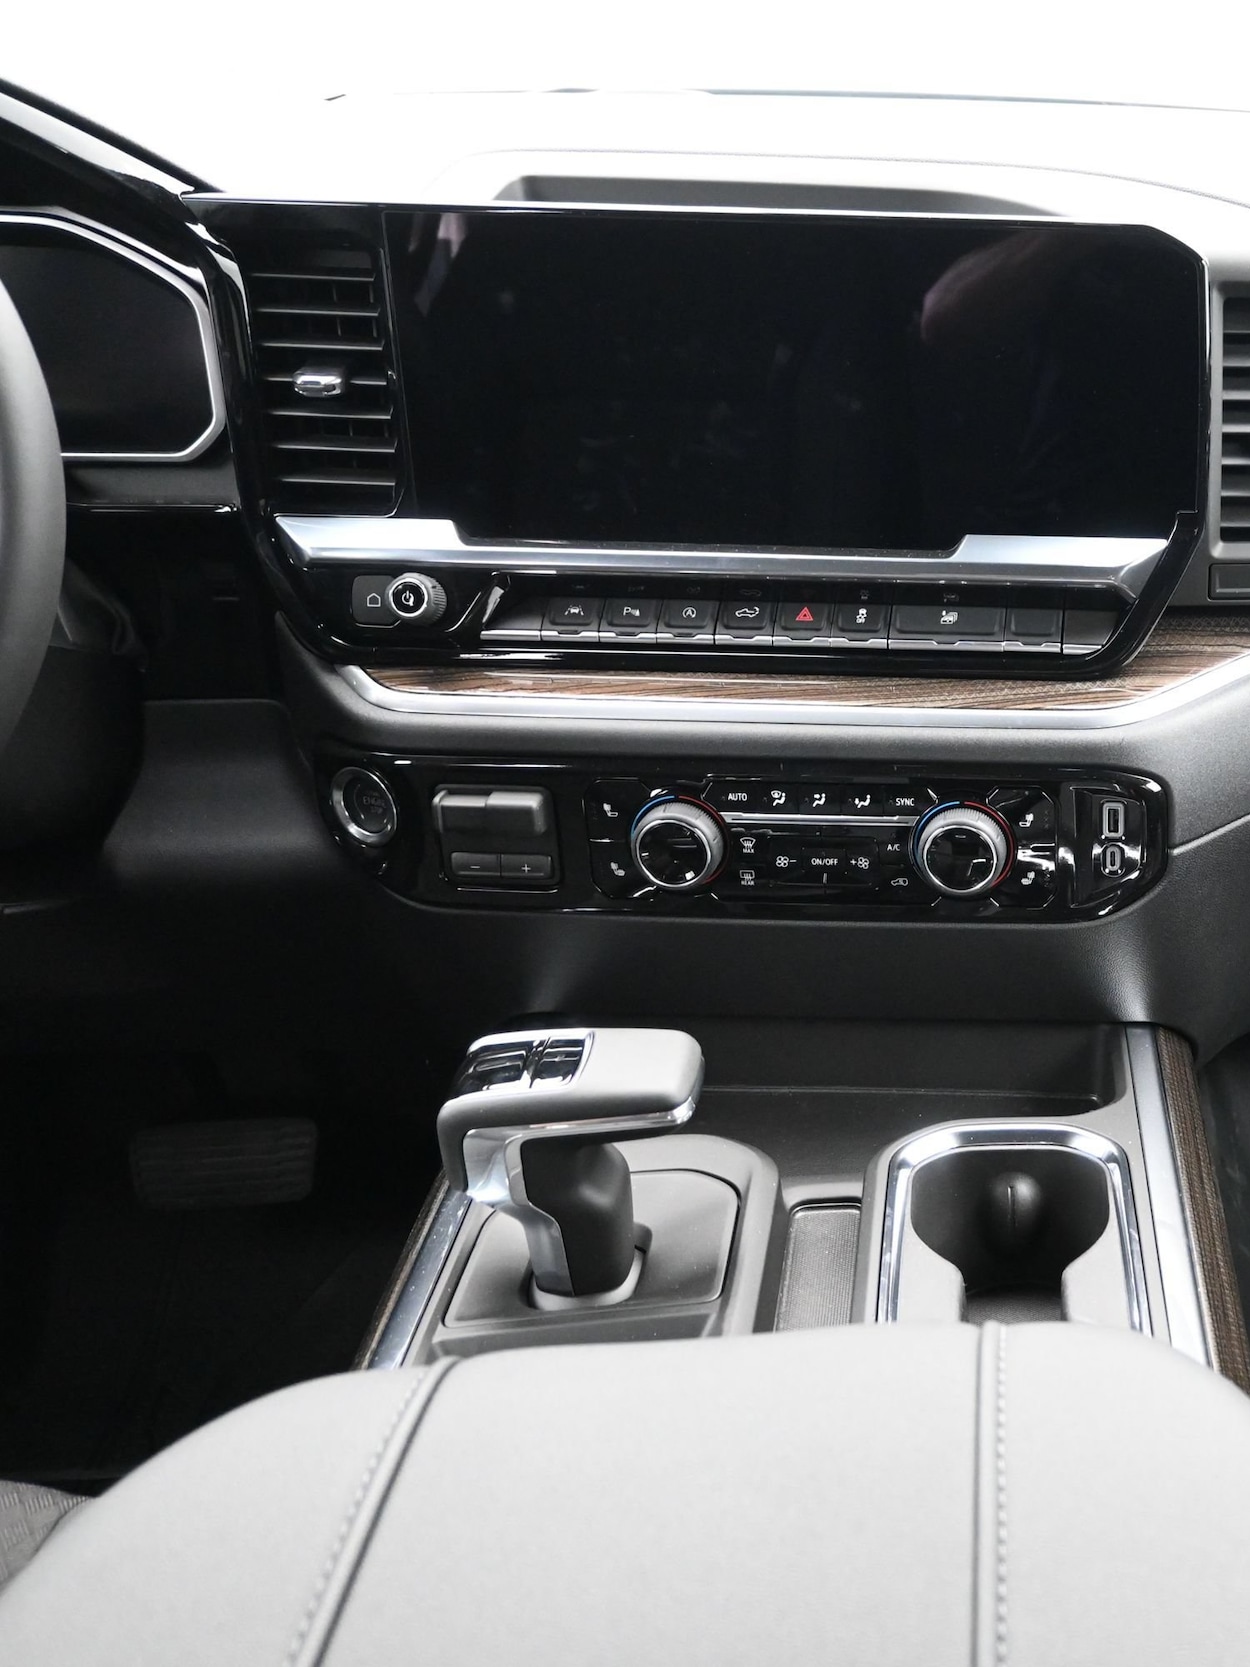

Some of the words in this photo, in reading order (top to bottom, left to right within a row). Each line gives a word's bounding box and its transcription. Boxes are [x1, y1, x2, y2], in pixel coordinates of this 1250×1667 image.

[727, 792, 748, 802] AUTO
[895, 797, 915, 807] SYNC
[886, 843, 901, 852] A/C
[811, 857, 839, 866] ON/OFF
